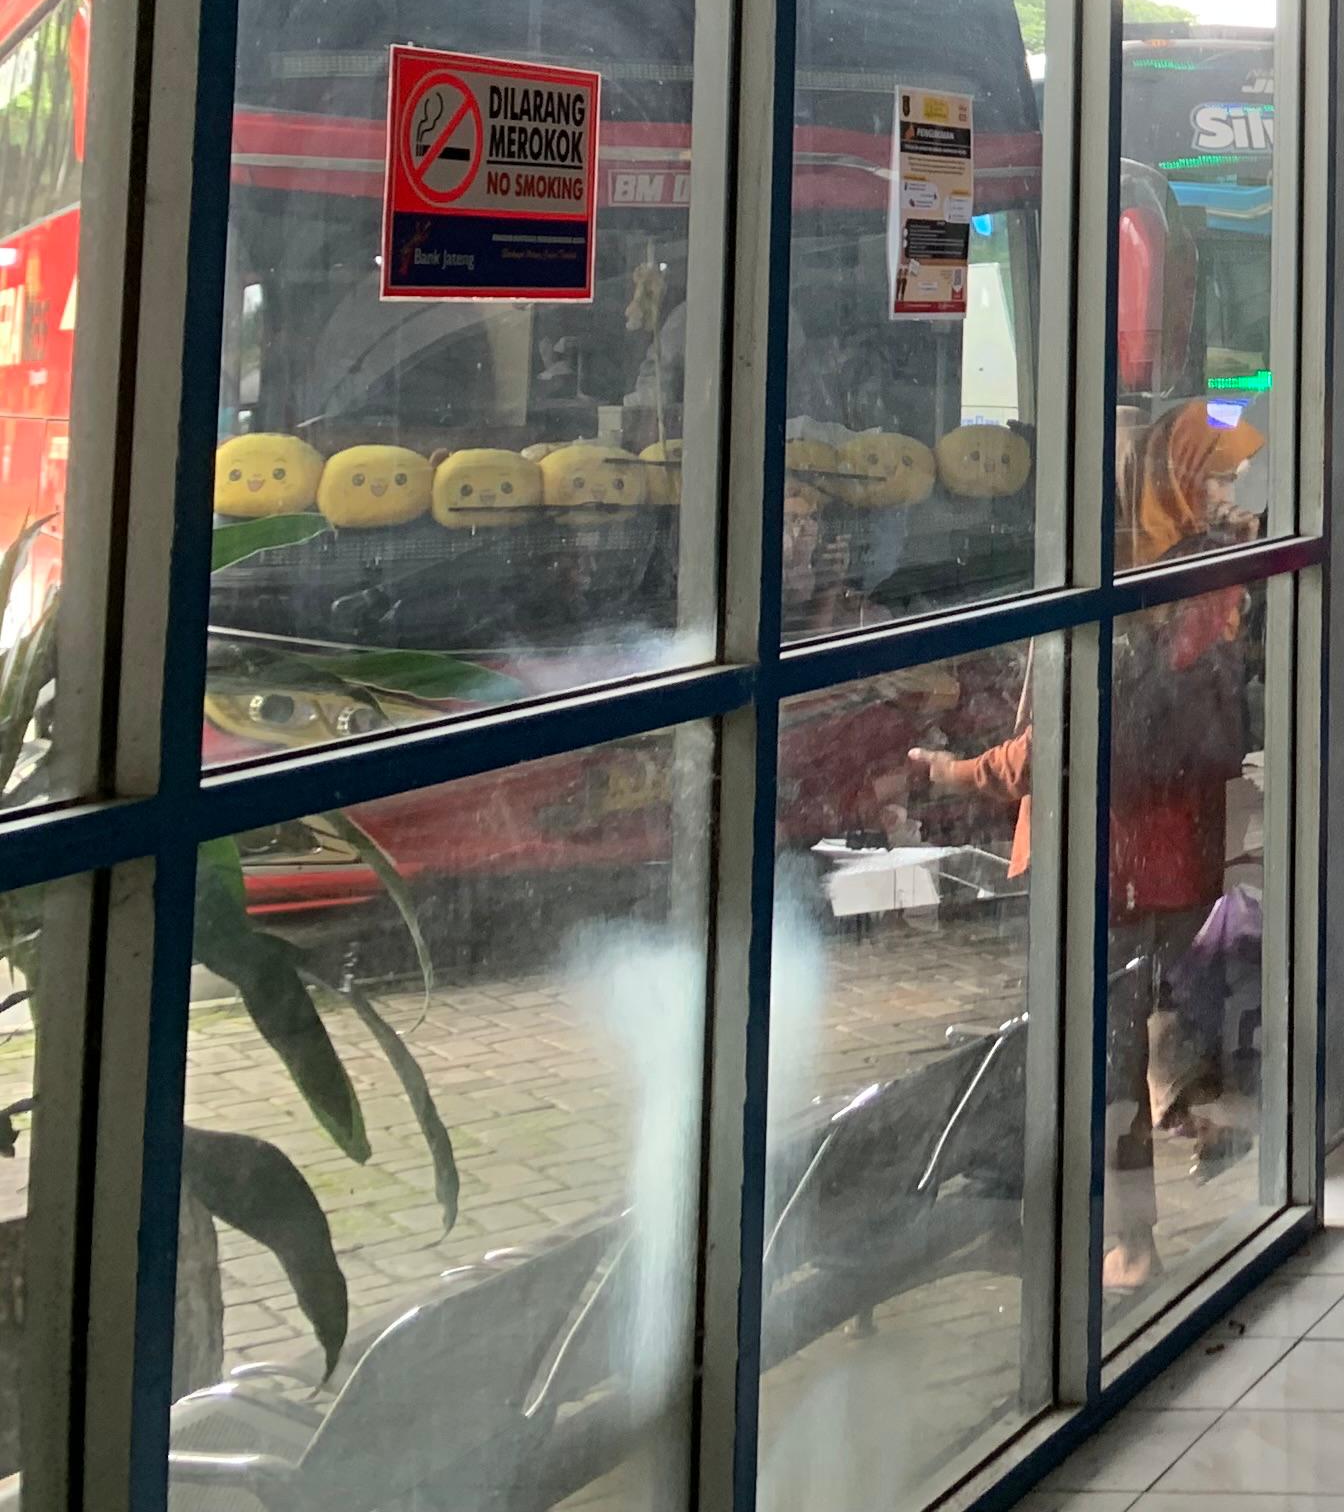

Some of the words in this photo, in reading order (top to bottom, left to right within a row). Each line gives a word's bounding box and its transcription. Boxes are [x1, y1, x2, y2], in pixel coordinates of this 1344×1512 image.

[489, 85, 585, 127] DILARANG
[488, 124, 583, 164] MEROKOK
[486, 171, 511, 196] NO
[514, 173, 584, 201] SMOKING
[613, 174, 665, 202] BM
[413, 247, 440, 266] Bank
[441, 249, 475, 270] Jateng
